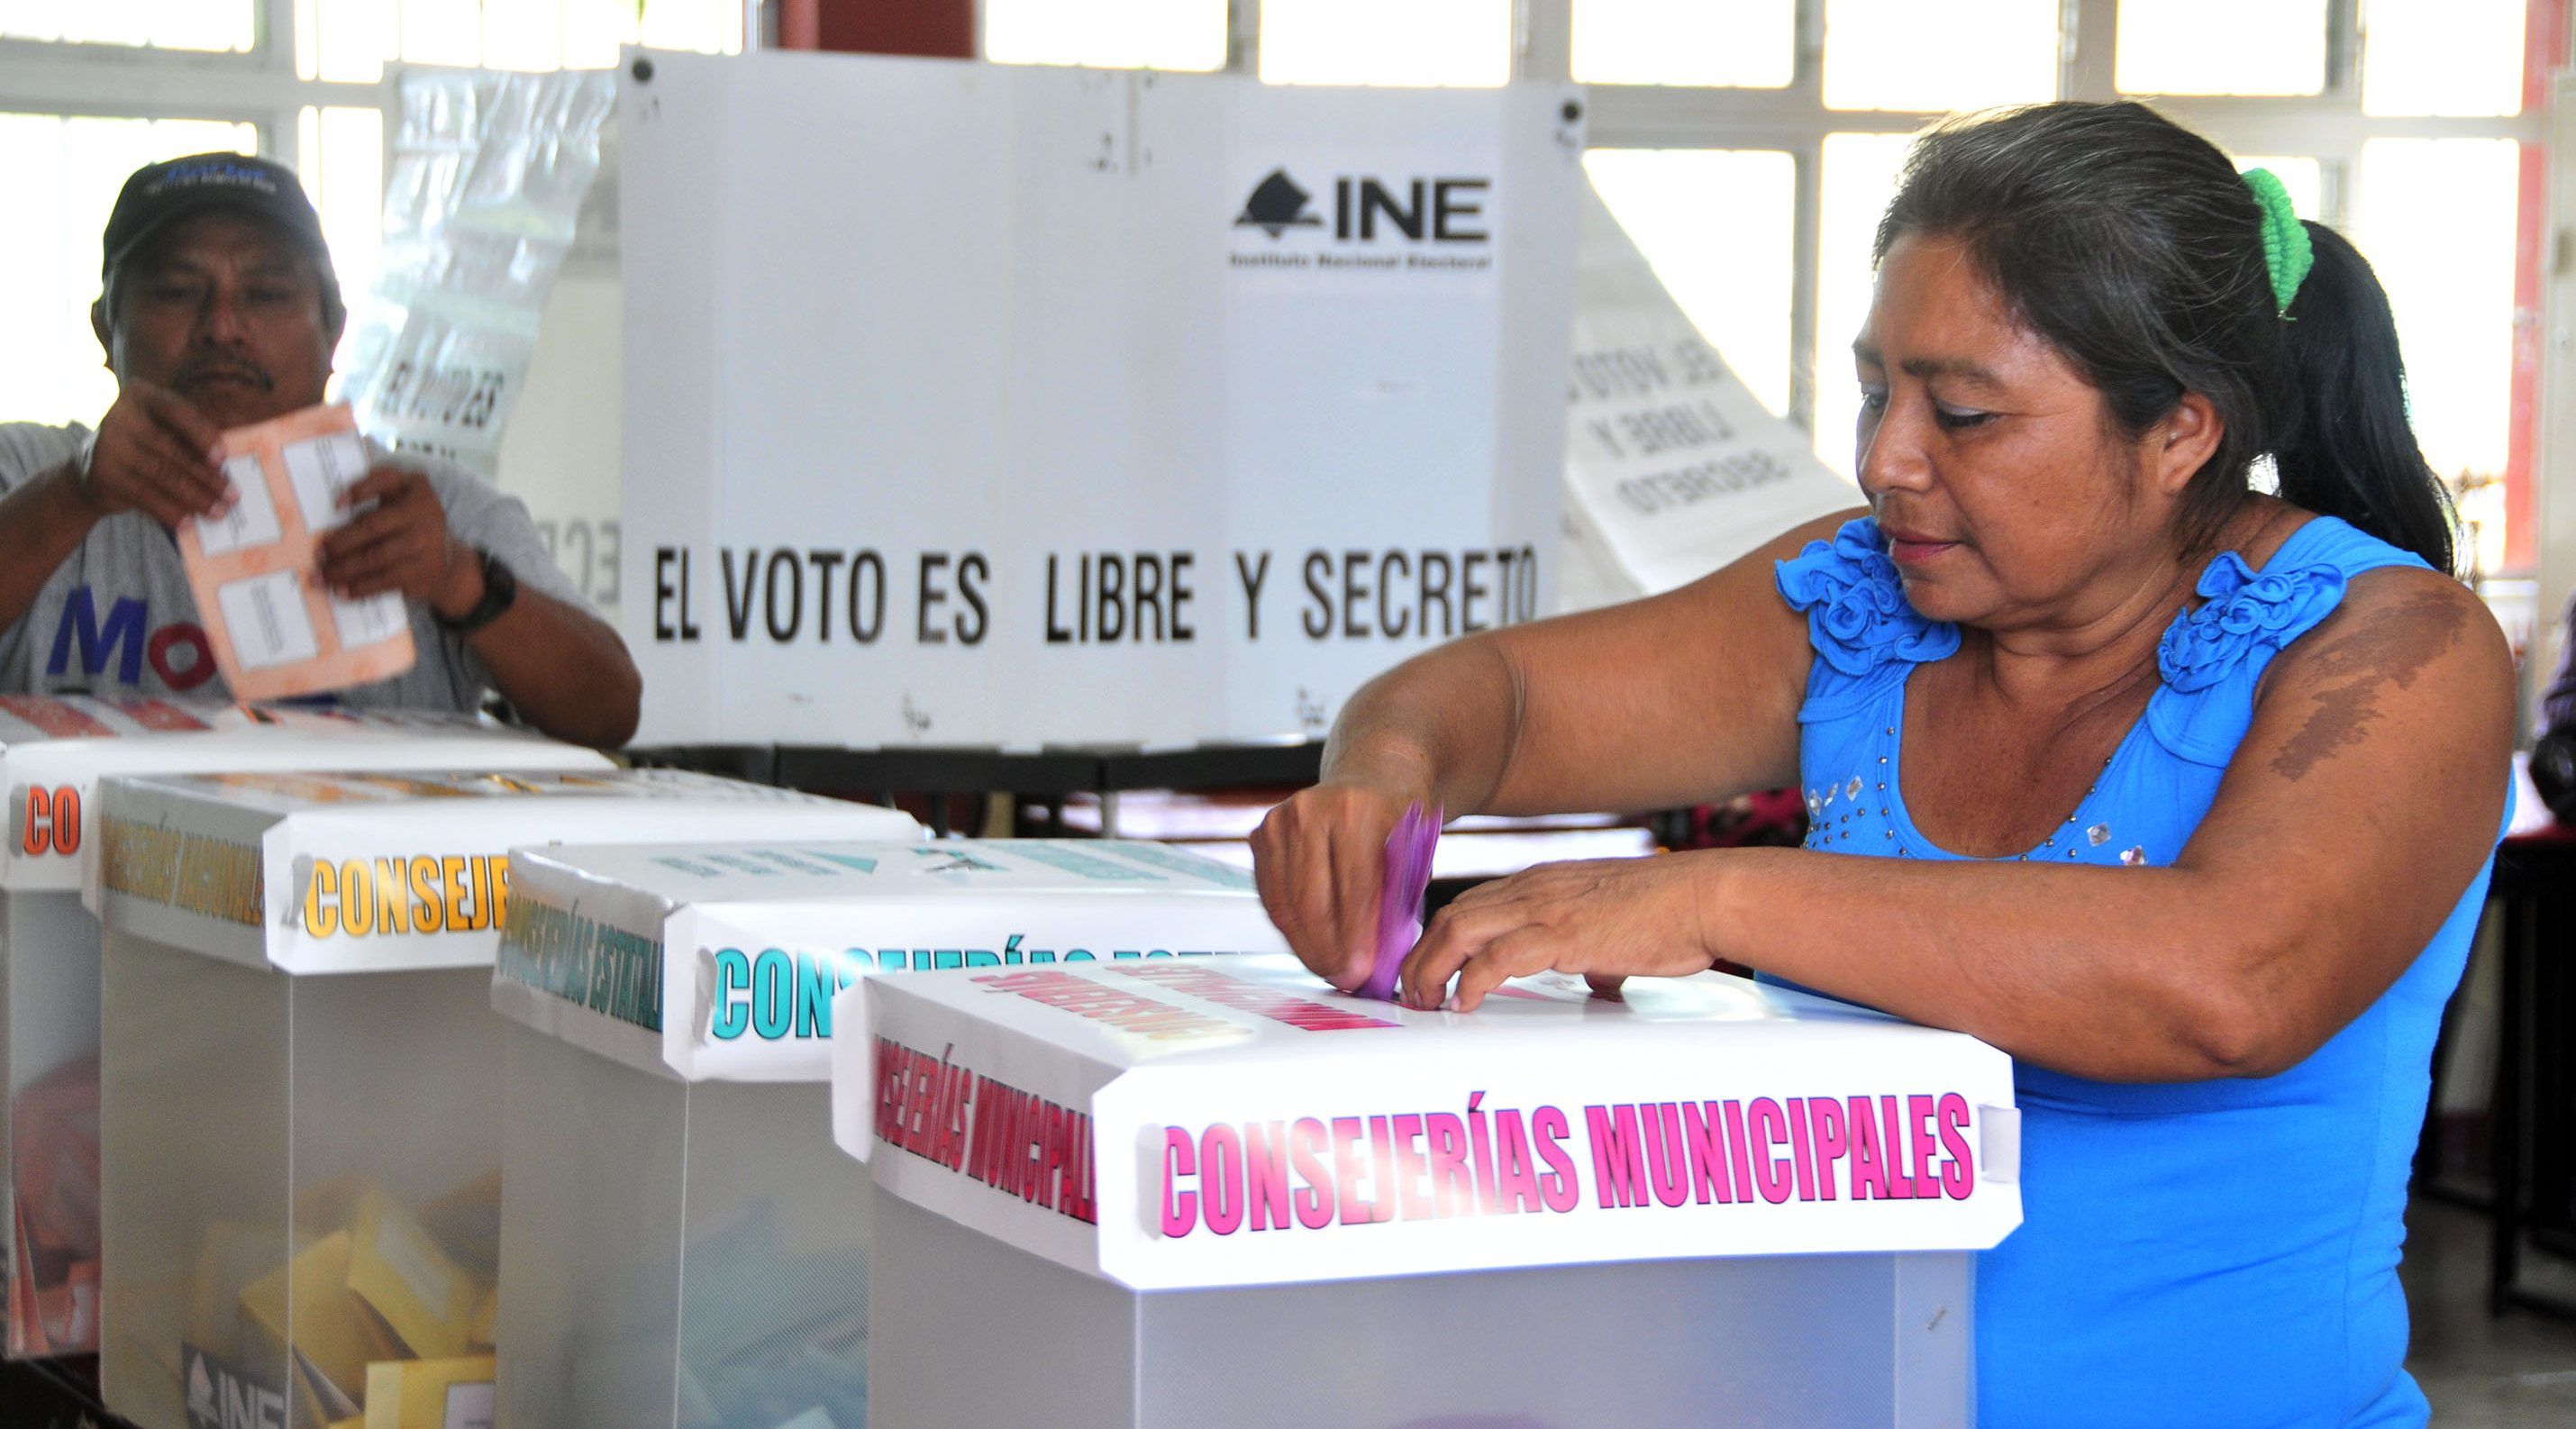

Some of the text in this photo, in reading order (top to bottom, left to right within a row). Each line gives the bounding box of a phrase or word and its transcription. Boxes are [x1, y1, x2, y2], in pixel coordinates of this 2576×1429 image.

[1335, 176, 1491, 242] INE
[655, 546, 1538, 645] EL VOTO ES LIBRE Y SECRETO
[1161, 1090, 1974, 1238] CONSEJERÍAS MUNICIPALES
